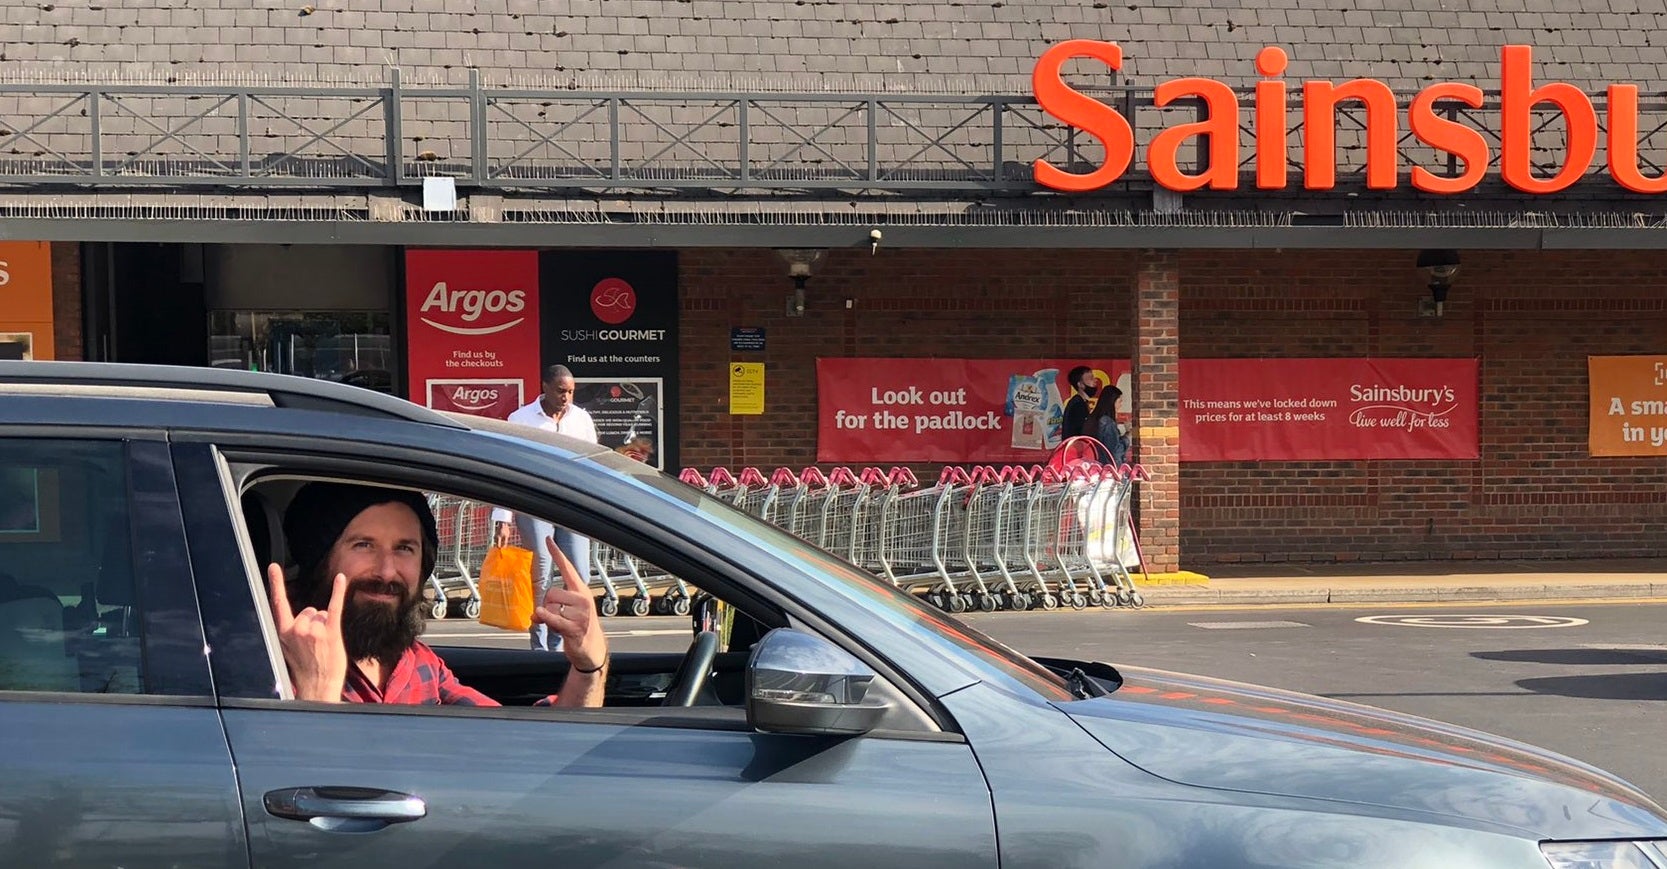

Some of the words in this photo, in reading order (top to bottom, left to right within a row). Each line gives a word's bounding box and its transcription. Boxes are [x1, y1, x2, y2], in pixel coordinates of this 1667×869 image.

[420, 281, 526, 321] Argos
[445, 359, 459, 367] the
[461, 359, 504, 367] checkouts
[453, 350, 471, 359] Find
[484, 350, 497, 361] by
[567, 354, 586, 363] Find
[599, 355, 608, 363] at
[609, 354, 623, 363] the
[625, 355, 661, 363] counters
[452, 386, 498, 404] Argos
[871, 386, 924, 405] Look
[929, 388, 967, 405] out
[1015, 391, 1041, 403] Andrex
[1183, 399, 1205, 409] This
[1207, 400, 1241, 409] means
[1243, 399, 1272, 409] we've
[1273, 398, 1306, 408] locked
[1308, 398, 1337, 408] down
[1349, 384, 1455, 406] Sainsbury's
[1608, 397, 1626, 416] A
[835, 409, 867, 429] for
[872, 410, 909, 430] the
[915, 410, 1002, 434] padlock
[1195, 412, 1227, 424] prices
[1229, 411, 1243, 422] for
[1245, 412, 1255, 422] at
[1257, 411, 1283, 422] least
[1285, 411, 1292, 421] 8
[1293, 411, 1326, 421] weeks
[1350, 411, 1378, 428] live
[1379, 411, 1407, 428] well
[1407, 412, 1427, 433] for
[1427, 411, 1450, 428] less
[1622, 421, 1645, 442] in
